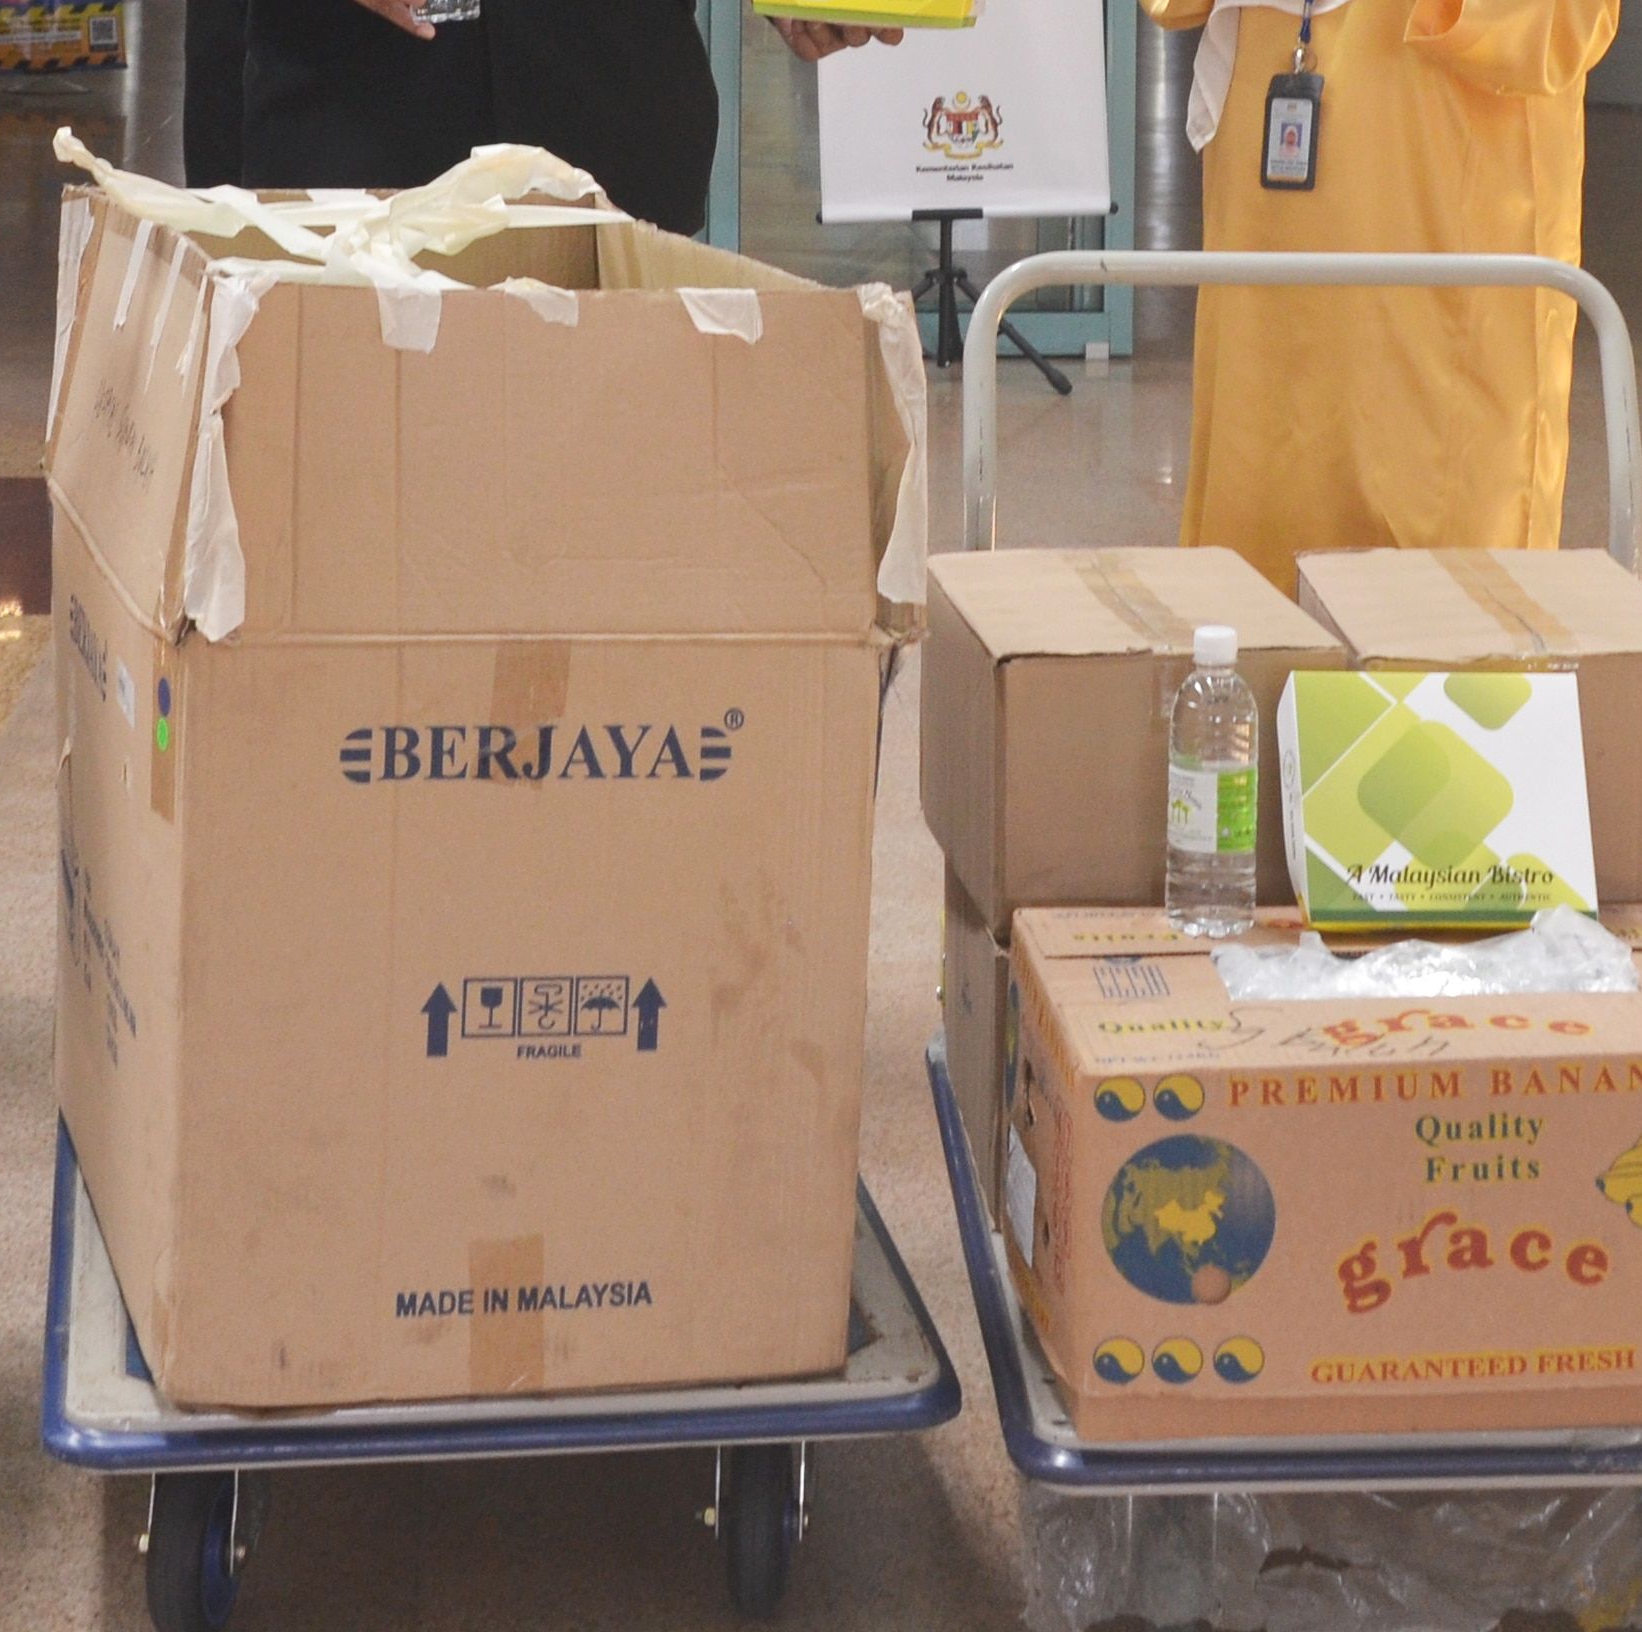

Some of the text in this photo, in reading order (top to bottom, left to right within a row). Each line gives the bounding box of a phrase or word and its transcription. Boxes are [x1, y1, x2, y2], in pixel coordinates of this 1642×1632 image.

[378, 723, 697, 783] BERJAYA
[1366, 863, 1482, 891] Malaysian
[1484, 863, 1555, 886] Bistro
[1098, 1019, 1225, 1035] Quality
[1321, 1008, 1594, 1048] grace
[516, 1044, 583, 1059] FRAGILE
[1228, 1069, 1463, 1107] PREMIUM
[1414, 1111, 1546, 1146] Quality
[1424, 1154, 1543, 1183] Fruits
[1335, 1208, 1613, 1315] grace
[395, 1280, 654, 1317] MADE IN MALAYSIA
[1309, 1347, 1638, 1387] GUARANTEED FRESH
